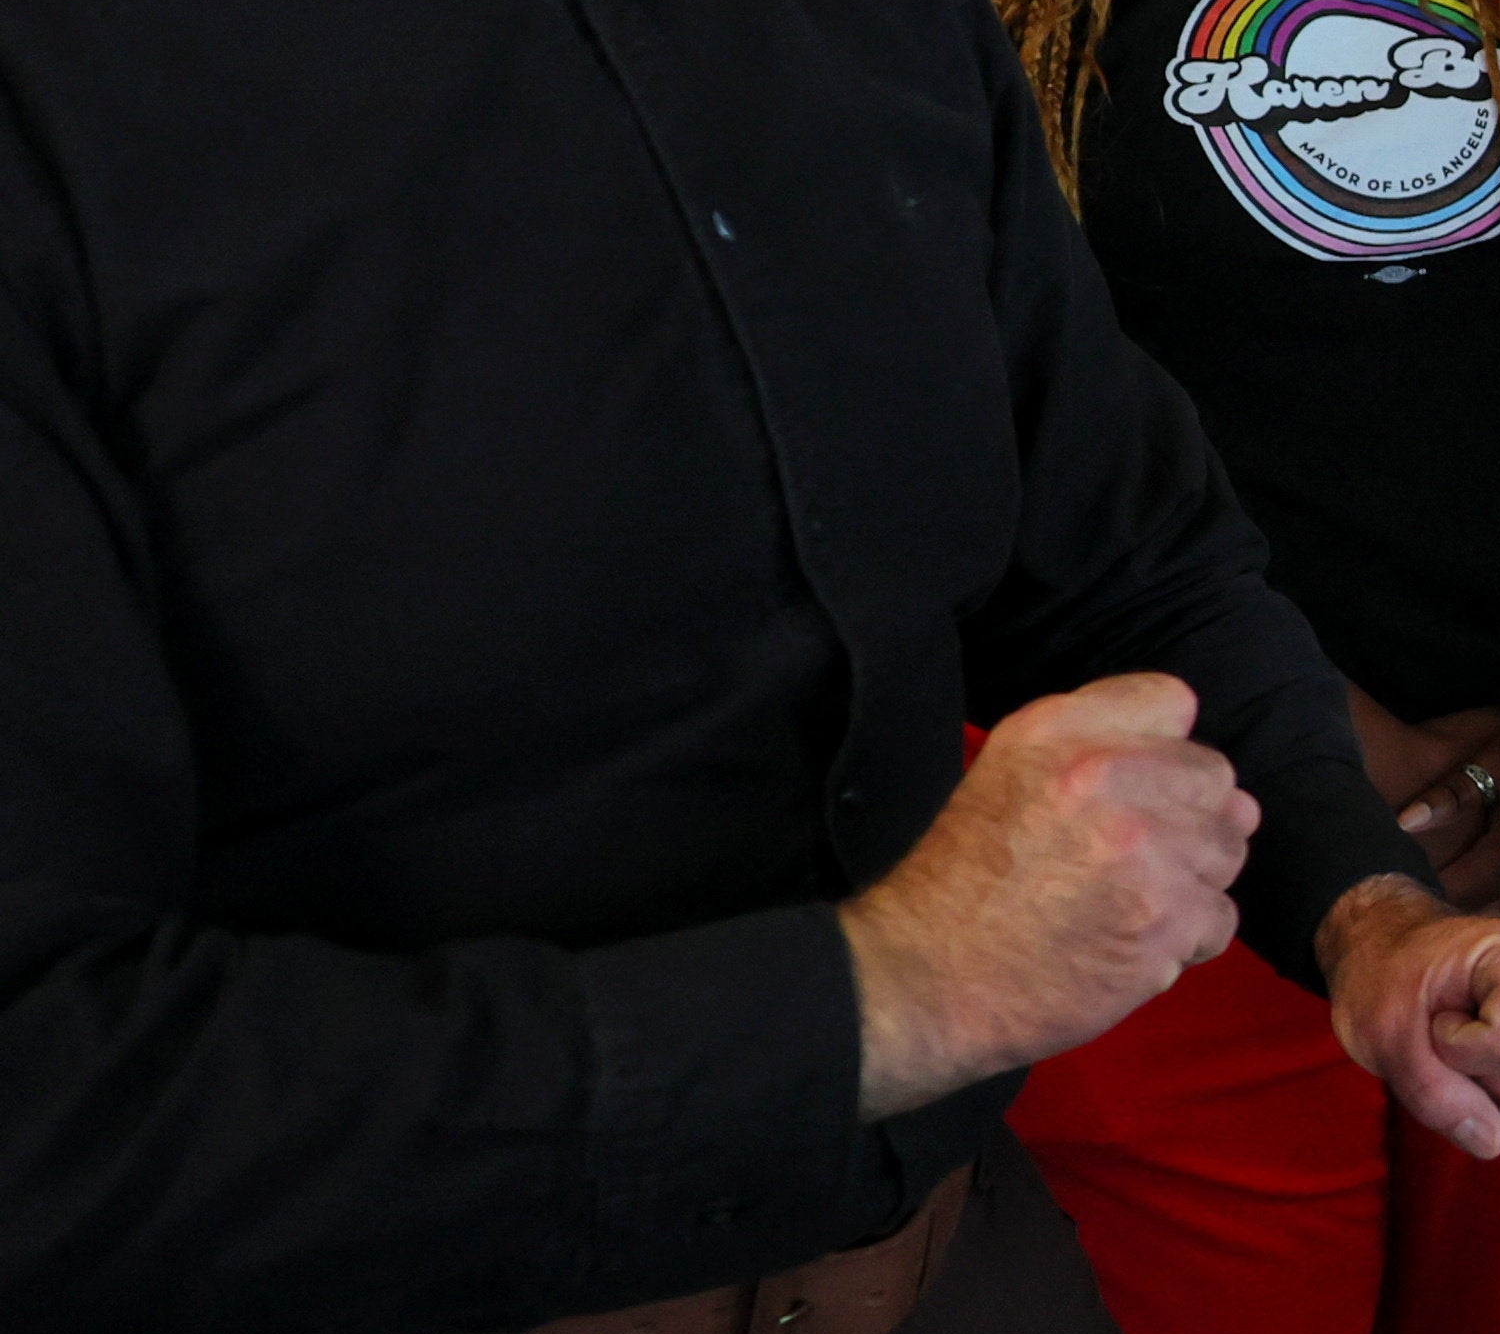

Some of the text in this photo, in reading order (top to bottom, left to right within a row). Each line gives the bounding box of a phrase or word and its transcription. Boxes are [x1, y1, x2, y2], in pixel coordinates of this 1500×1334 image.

[1177, 55, 1391, 119] Karen
[1300, 107, 1490, 193] MAYOR OF LOS ANGELES
